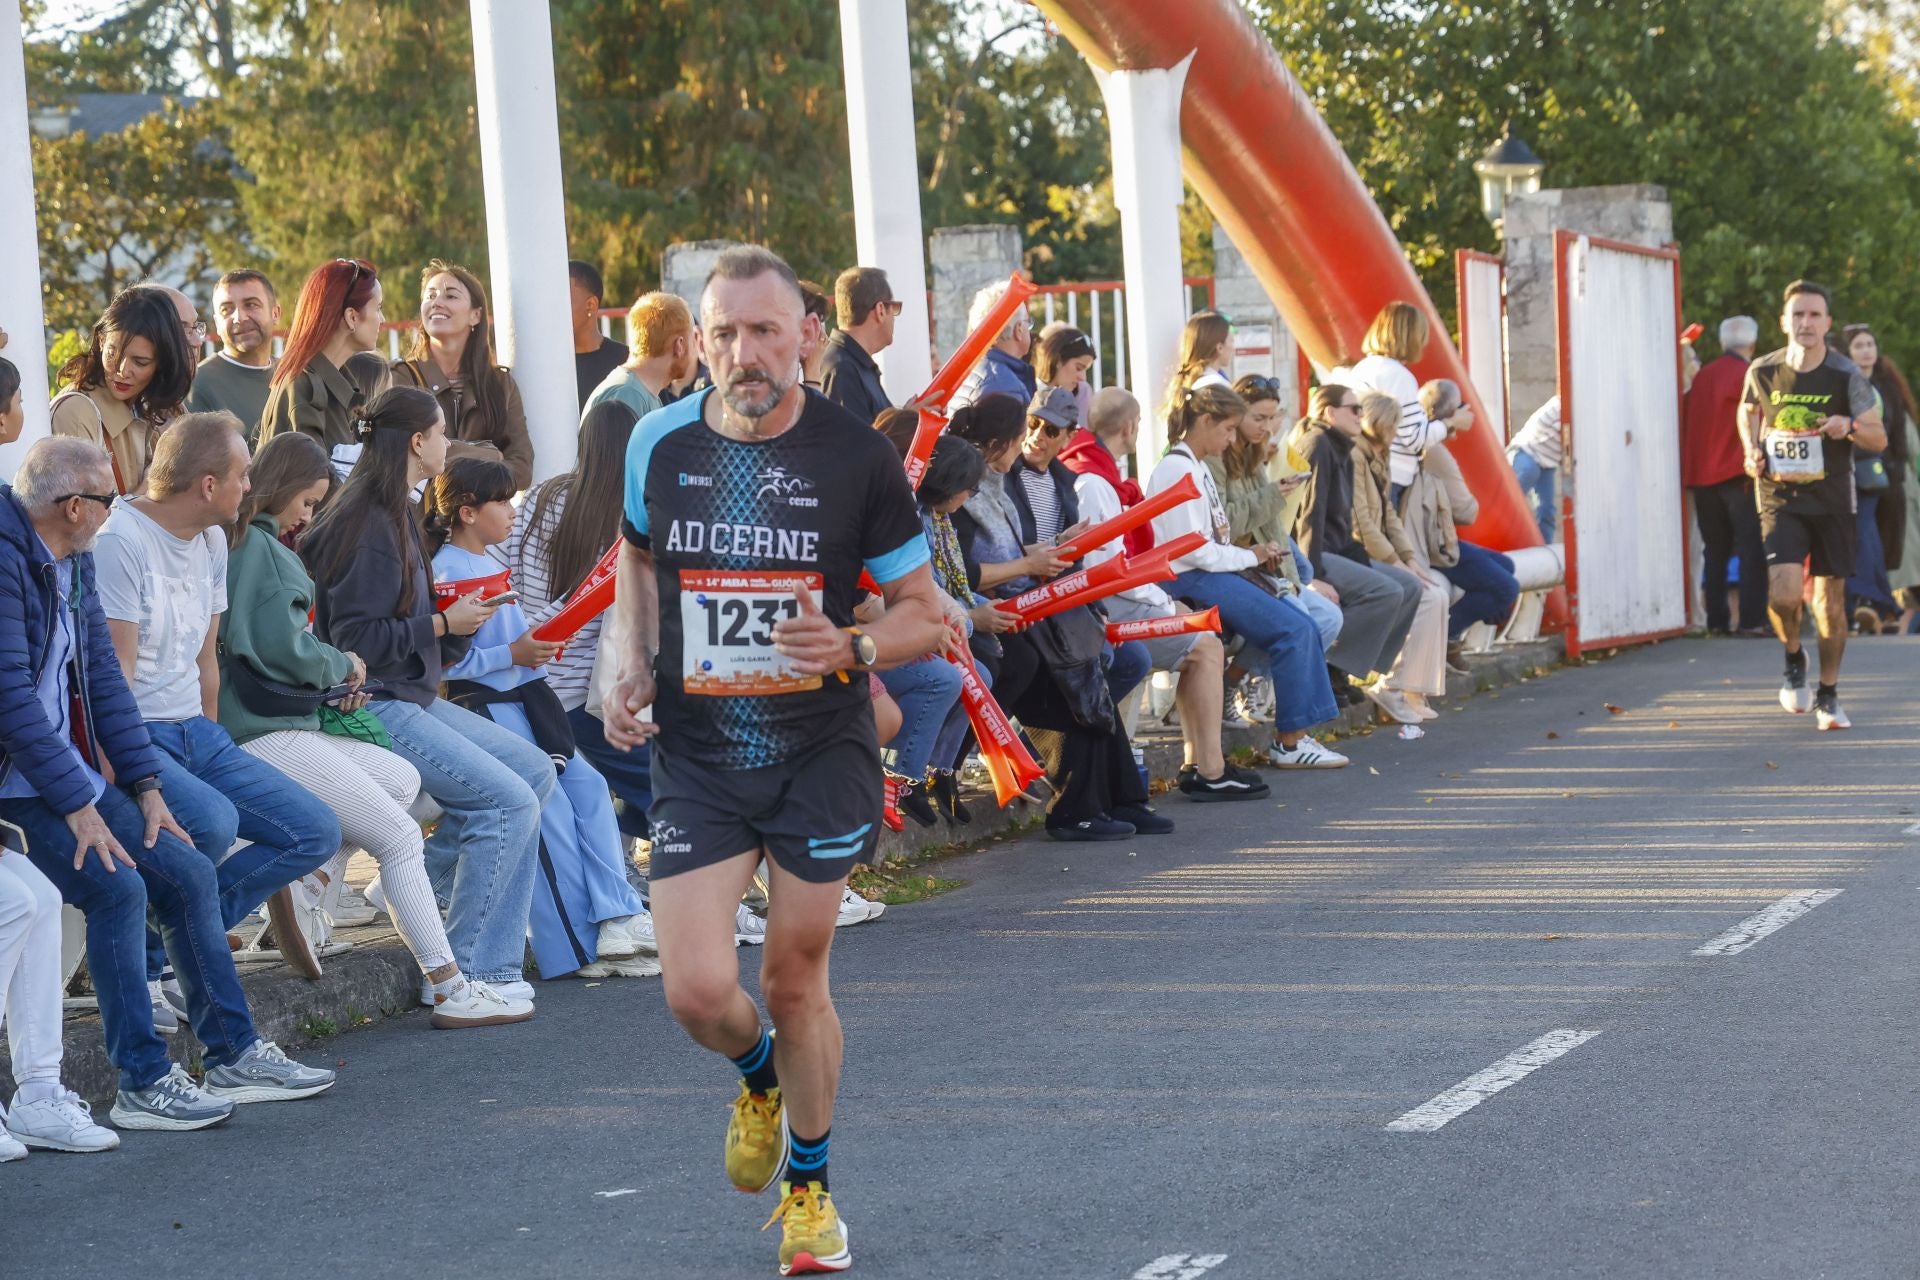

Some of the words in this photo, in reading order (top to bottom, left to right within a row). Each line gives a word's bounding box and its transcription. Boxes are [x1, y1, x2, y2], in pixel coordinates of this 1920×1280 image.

[1774, 440, 1809, 460] 588
[788, 496, 819, 507] cerne
[665, 519, 705, 553] AD
[709, 522, 820, 562] CERNE
[720, 577, 750, 588] MBA
[1016, 585, 1051, 610] MBA
[1052, 573, 1090, 598] MBA
[663, 843, 692, 853] cerne
